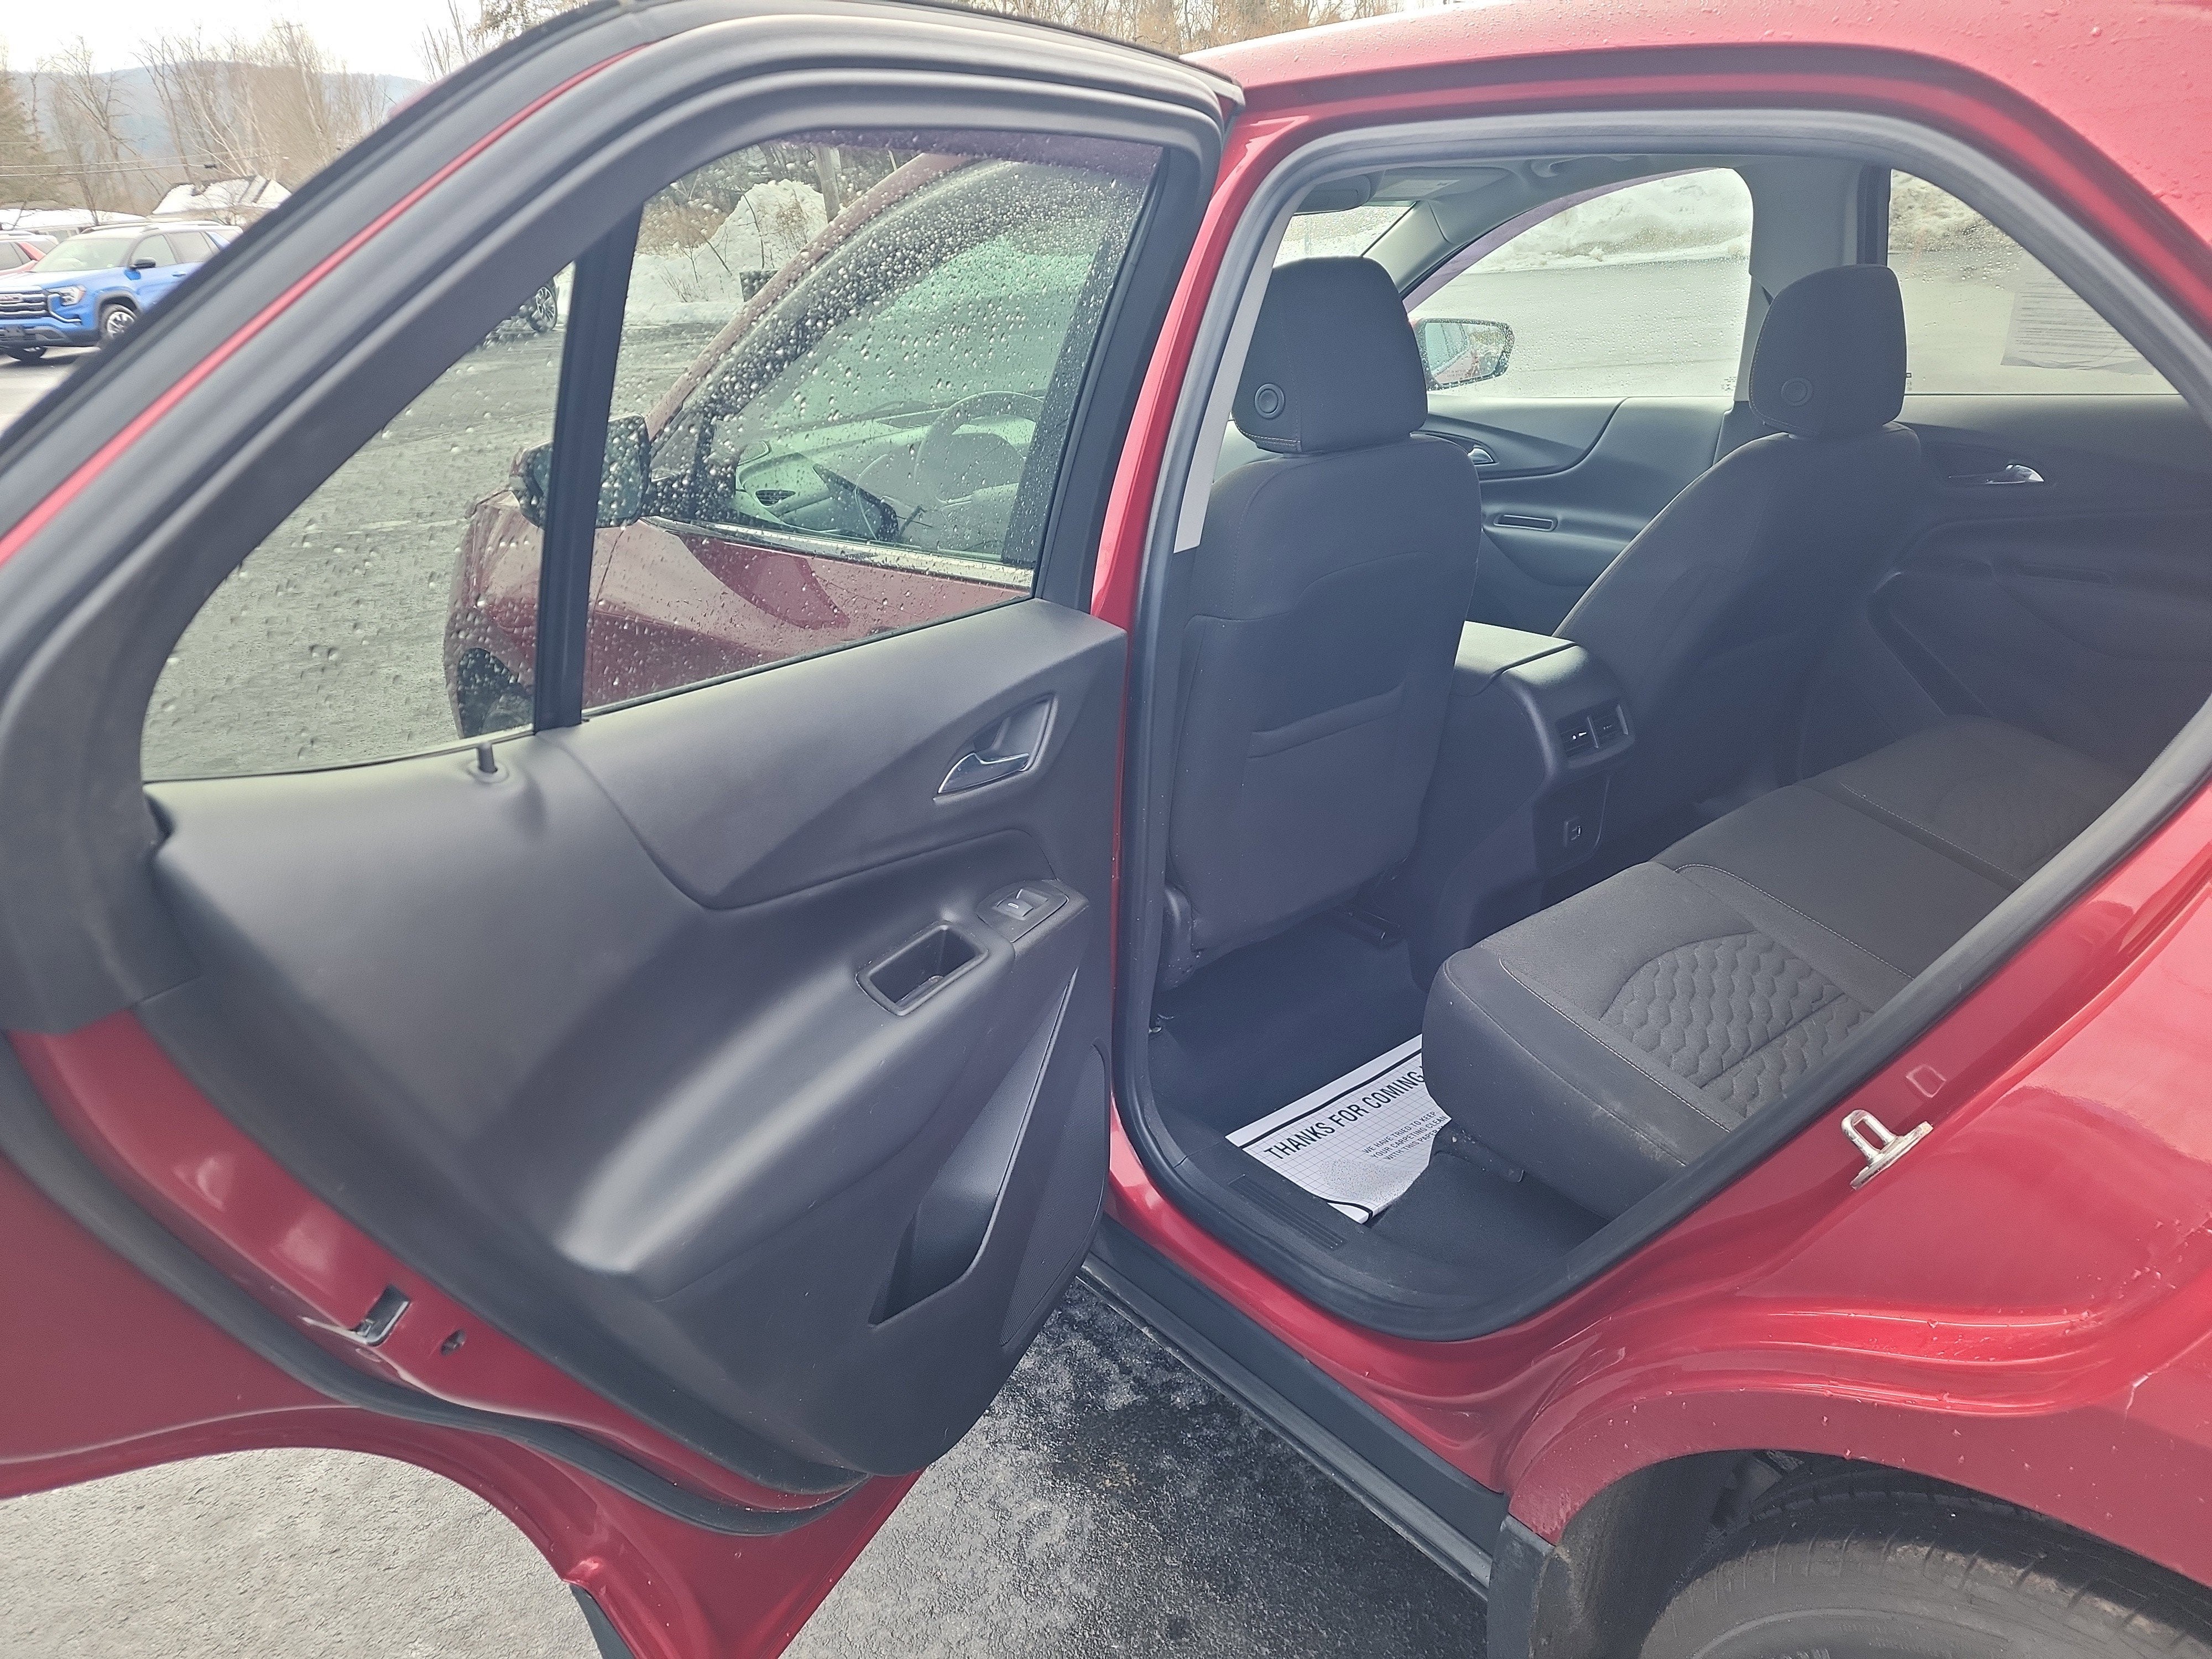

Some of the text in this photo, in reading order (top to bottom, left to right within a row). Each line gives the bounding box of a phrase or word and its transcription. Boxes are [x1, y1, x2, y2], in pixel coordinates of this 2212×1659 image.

[1264, 1071, 1425, 1159] THANKS FOR COMING
[1362, 1111, 1437, 1154] WE HAVE TRIED TO KEEP
[1370, 1115, 1448, 1159] YOUR CARPETING CLEAN
[1384, 1149, 1405, 1161] WITH
[1401, 1141, 1420, 1151] THIS
